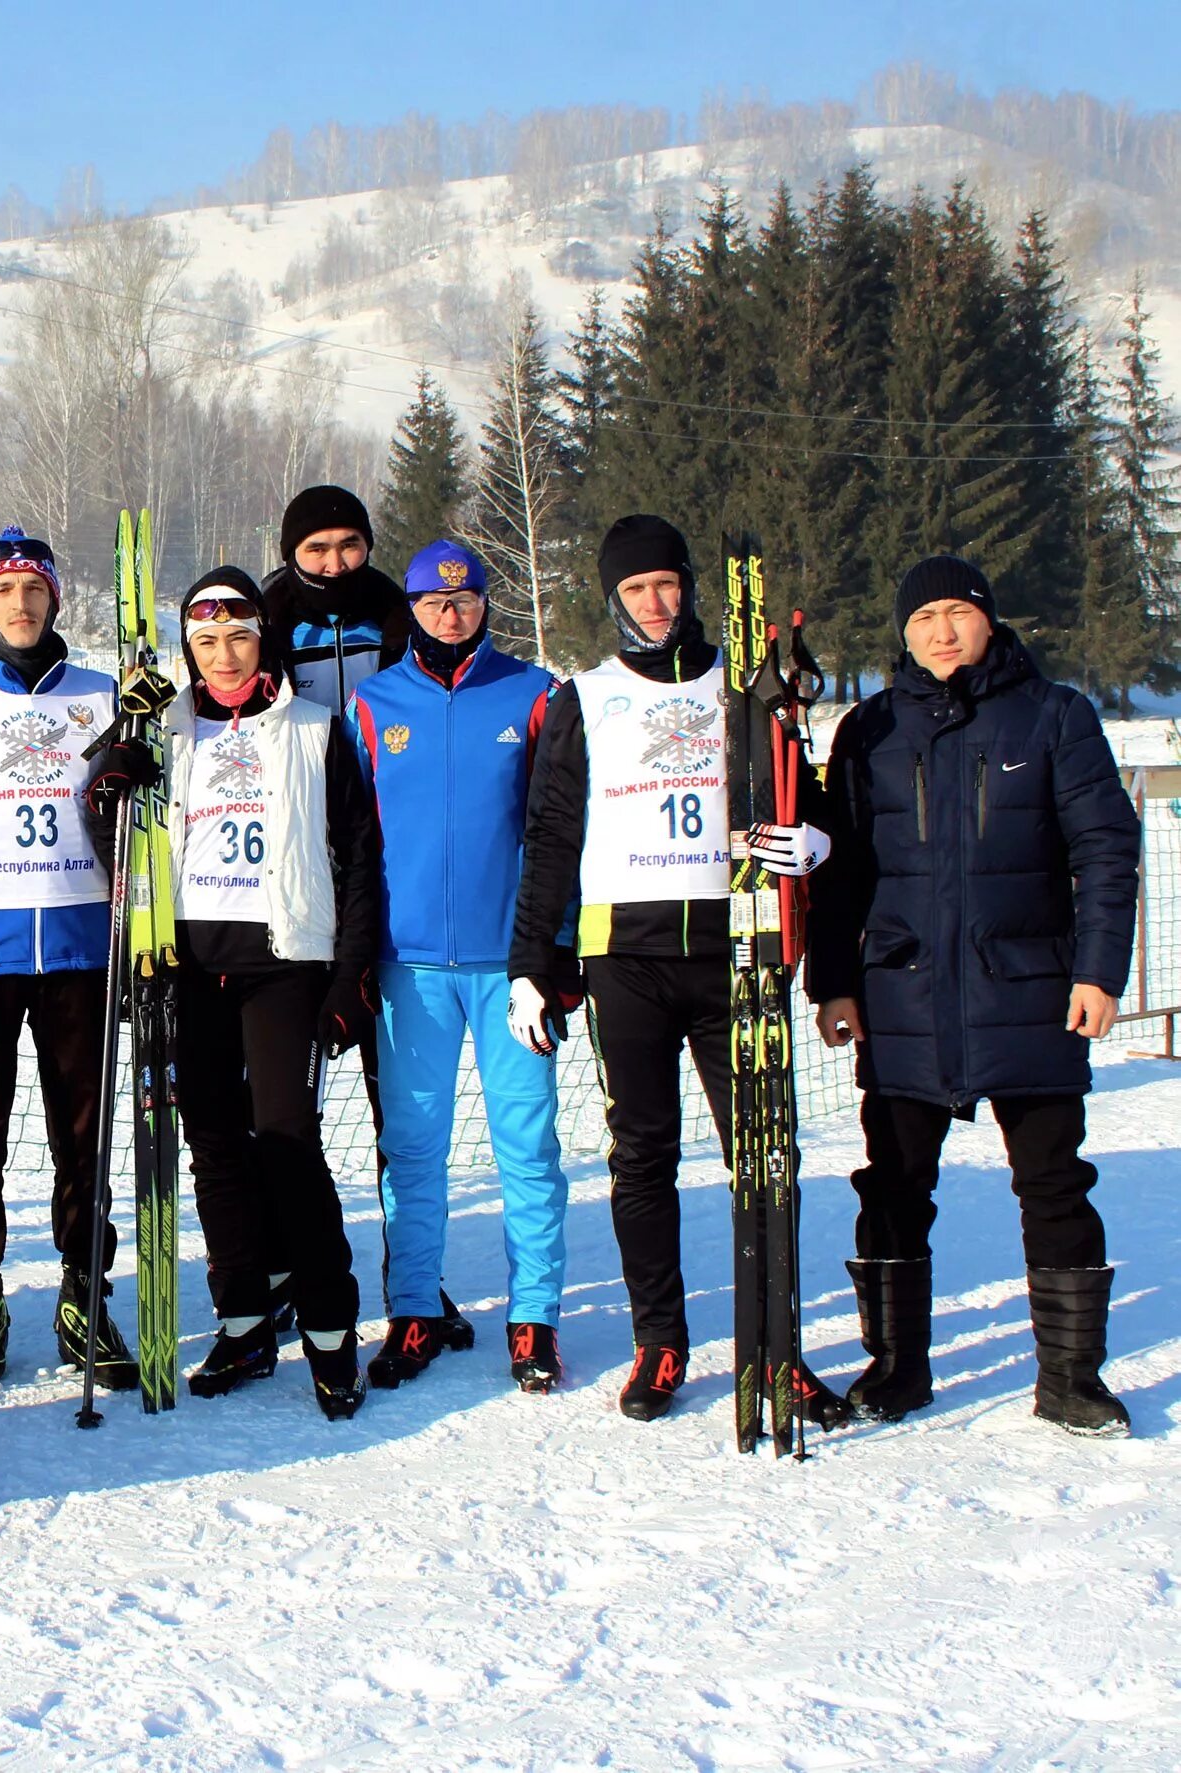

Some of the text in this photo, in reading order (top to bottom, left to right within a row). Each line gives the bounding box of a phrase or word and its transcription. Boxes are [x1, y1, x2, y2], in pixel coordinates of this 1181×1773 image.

[748, 555, 766, 669] ISCHER
[726, 556, 745, 694] FISCHER
[644, 697, 705, 719] ЛЫЖНЯ
[1, 710, 58, 729] ЛЫЖНЯ
[214, 729, 256, 750] ЛЫЖ
[690, 738, 721, 748] 2019
[43, 750, 71, 761] 2019
[652, 757, 713, 775] РОССИИ
[8, 769, 64, 785] РОССИИ
[19, 788, 71, 799] РОССИИ
[217, 786, 263, 800] РОССИ
[605, 781, 658, 798] ЛЫЖНЯ
[663, 777, 719, 789] РОССИИ
[660, 793, 703, 839] 18
[15, 803, 59, 848] 33
[219, 821, 264, 865] 36
[64, 858, 95, 872] Алтай
[629, 851, 708, 868] Республика
[189, 874, 260, 889] Республика
